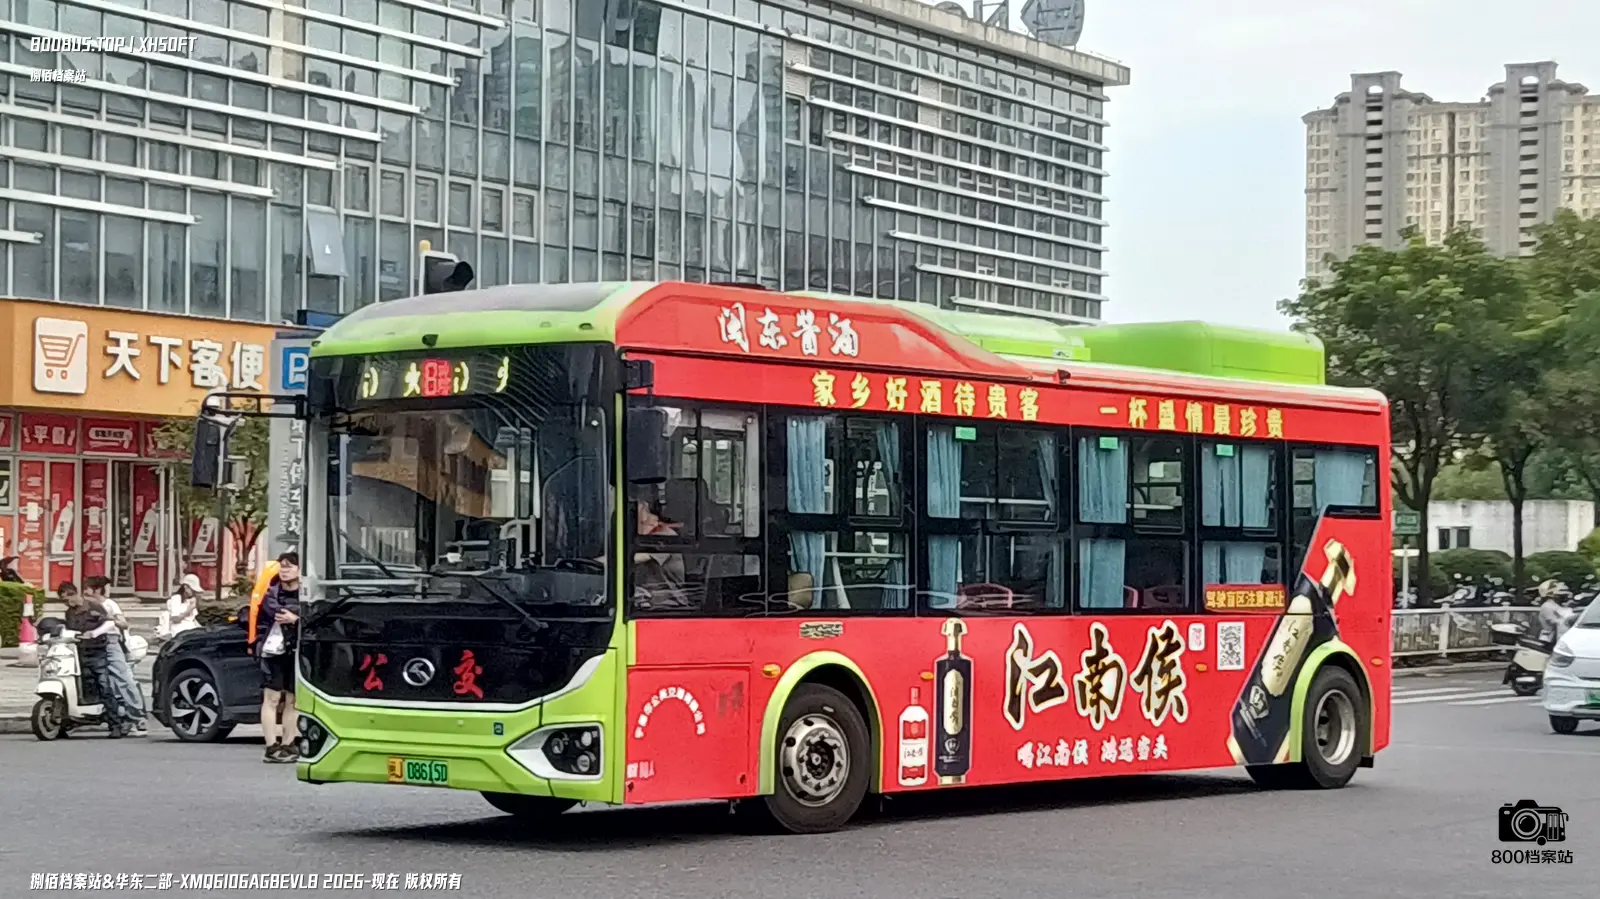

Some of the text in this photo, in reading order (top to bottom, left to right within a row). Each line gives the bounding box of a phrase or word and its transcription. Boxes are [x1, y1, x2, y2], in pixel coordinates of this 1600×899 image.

[103, 329, 266, 391] 天下客便
[811, 369, 1284, 439] 家乡好酒待贵客 一杯盛情最珍贵
[1003, 619, 1189, 732] 江南侯
